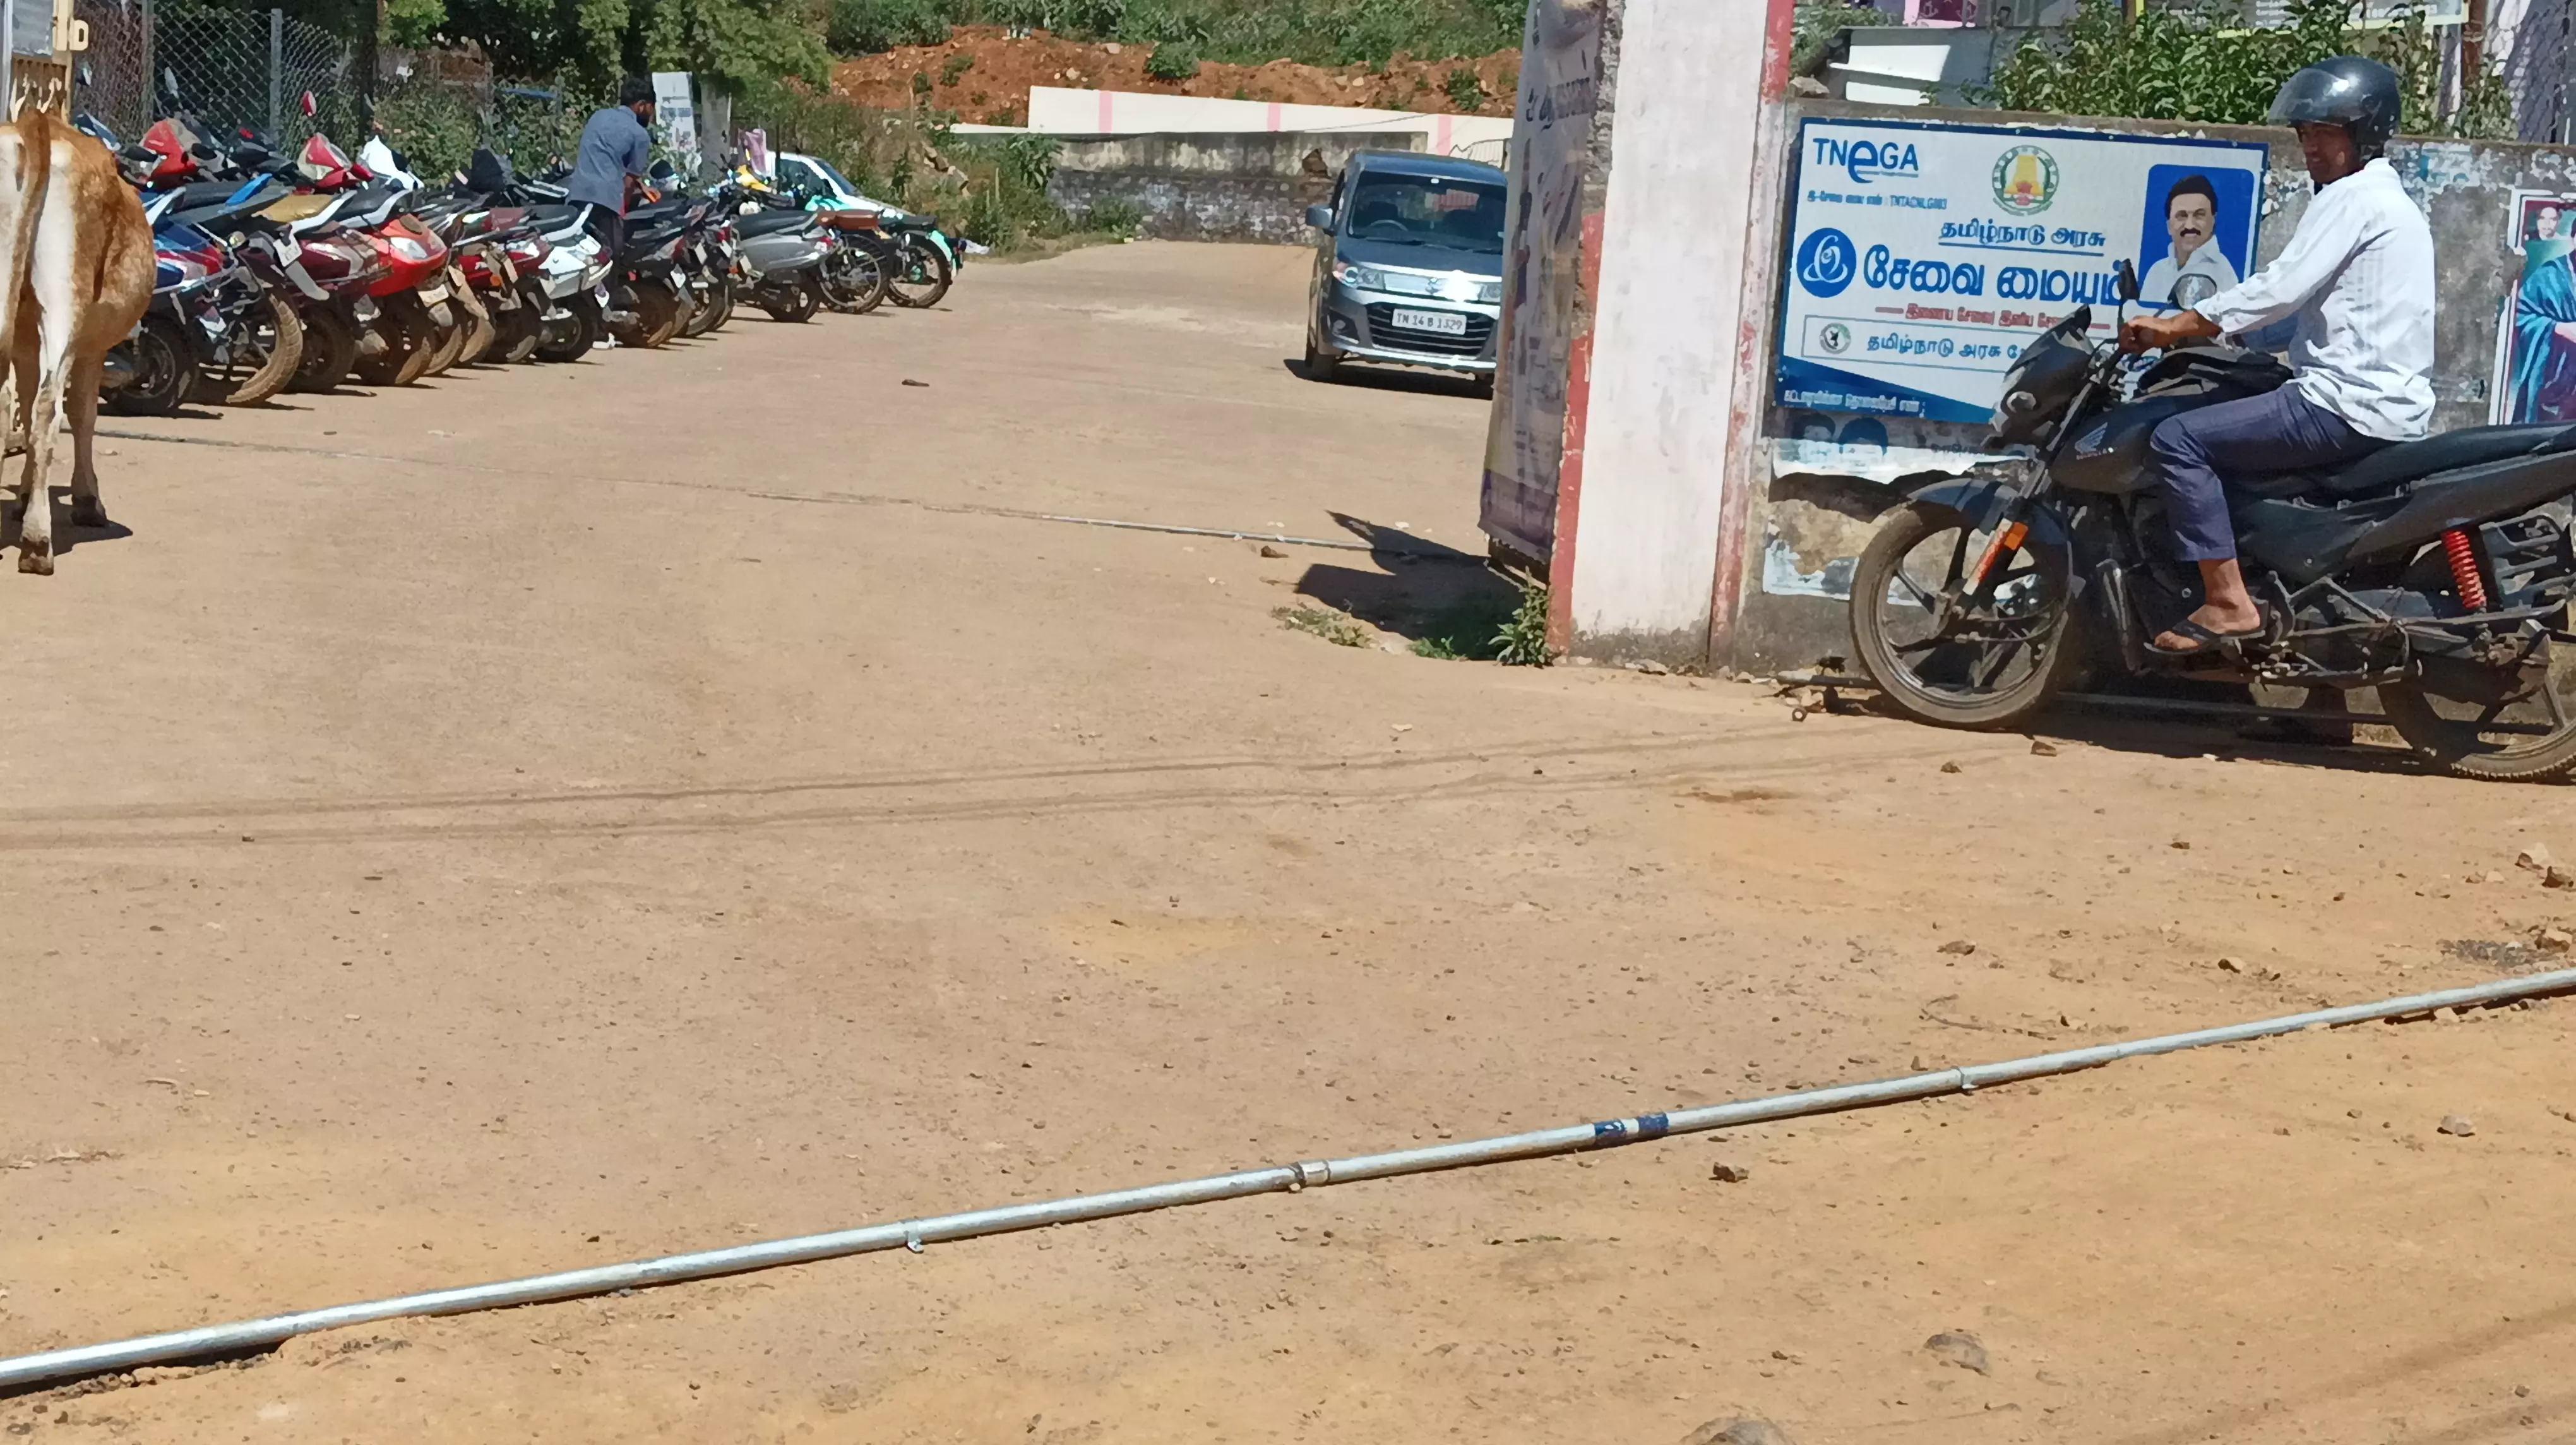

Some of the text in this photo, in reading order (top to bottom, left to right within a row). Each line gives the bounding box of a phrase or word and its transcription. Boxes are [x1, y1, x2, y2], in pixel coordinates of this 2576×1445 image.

[1938, 218, 2106, 248] தமிழ்நாடு அரசு
[1863, 244, 1985, 296] சேவை
[1867, 332, 1954, 357] தமிழ்நாடு
[1959, 343, 2001, 360] அரசு
